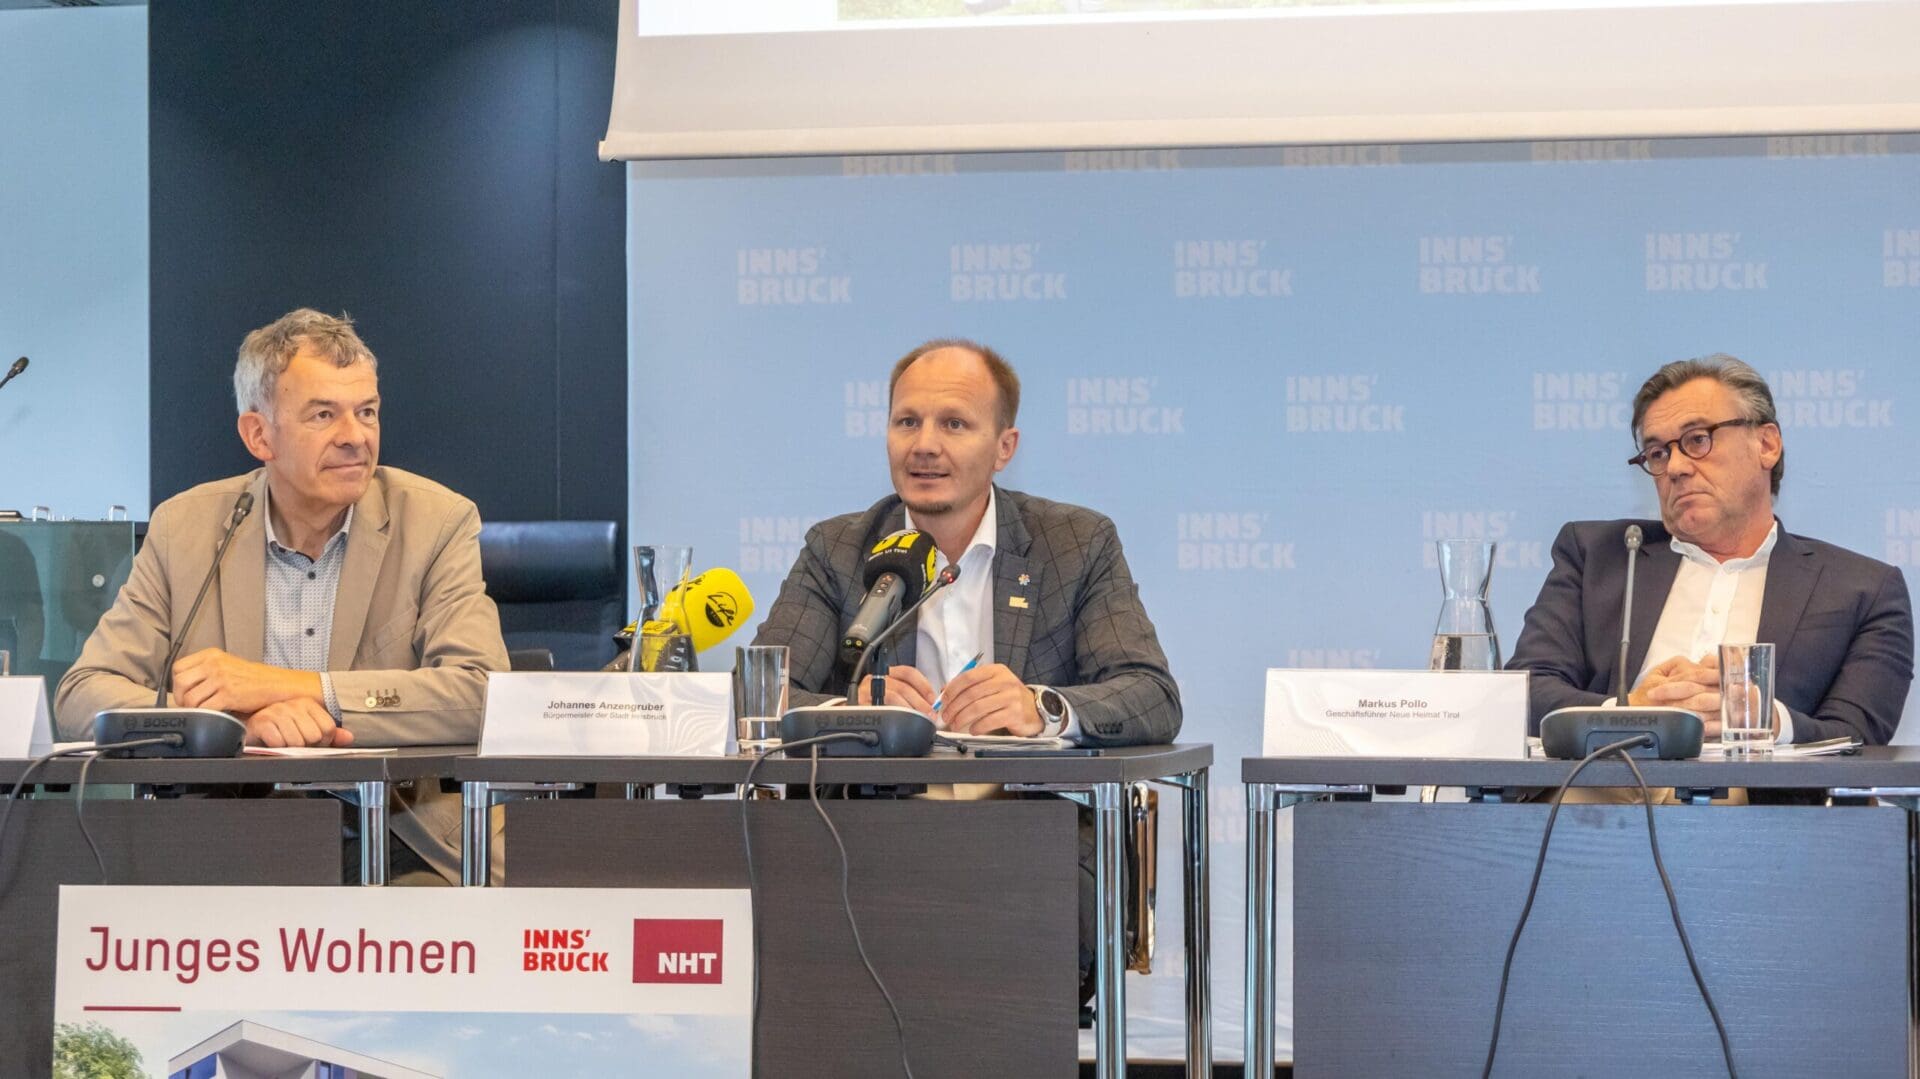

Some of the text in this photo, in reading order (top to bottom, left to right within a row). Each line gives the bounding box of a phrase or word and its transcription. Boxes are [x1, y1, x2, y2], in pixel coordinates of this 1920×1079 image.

[1065, 150, 1184, 174] BRUCK
[1284, 145, 1400, 168] BRUCK
[1531, 140, 1652, 164] BRUCK
[1767, 136, 1889, 160] BRUCK
[842, 154, 958, 178] BRUCK
[950, 242, 1040, 272] INNS'
[1174, 239, 1267, 268] INNS'
[1419, 235, 1515, 264] INNS'
[1645, 231, 1741, 261] INNS'
[738, 247, 827, 275] INNS'
[738, 276, 852, 304] BRUCK
[950, 272, 1066, 300] BRUCK
[1174, 269, 1294, 298] BRUCK
[1419, 264, 1541, 293] BRUCK
[1645, 262, 1768, 290] BRUCK
[1067, 376, 1158, 405] INNS'
[1286, 372, 1379, 402] INNS'
[1533, 371, 1627, 401] INNS'
[1067, 406, 1183, 434] BRUCK
[1286, 403, 1406, 432] BRUCK
[1533, 402, 1635, 430] BRUC
[1177, 512, 1272, 541] INNS'
[1177, 541, 1295, 570] BRUCK
[543, 712, 593, 720] Bürgermeister
[609, 712, 629, 720] Stadt
[548, 701, 664, 712] Johannes Anzengruber
[1326, 710, 1460, 719] Geschäftsführer Neue Heimat Tirol
[1358, 699, 1428, 708] Markus Pollo
[143, 717, 186, 728] BOSCH
[836, 715, 881, 726] BOSCH
[1609, 716, 1658, 727] BOSCH
[523, 928, 592, 949] INNS'
[86, 926, 477, 984] Junges Wohnen
[523, 952, 609, 973] BRUCK
[658, 952, 717, 975] NHT
